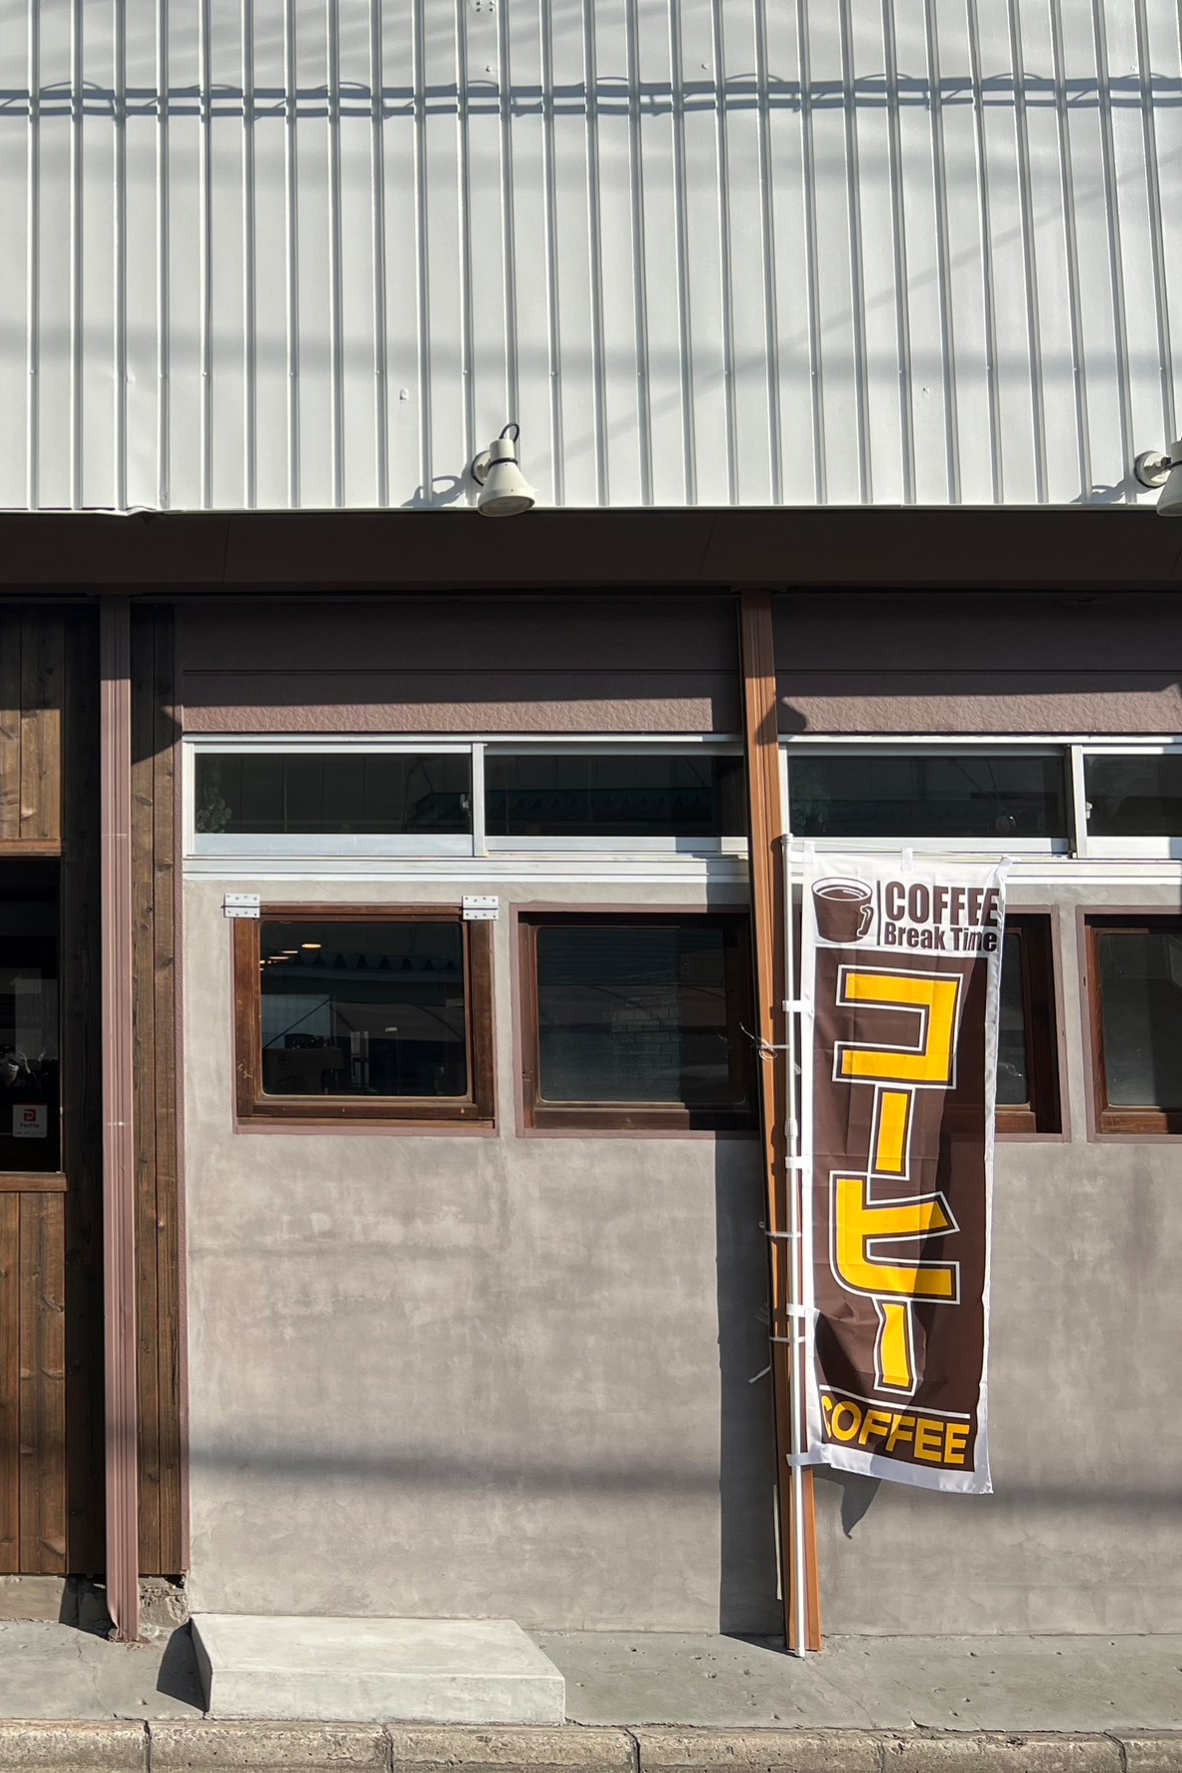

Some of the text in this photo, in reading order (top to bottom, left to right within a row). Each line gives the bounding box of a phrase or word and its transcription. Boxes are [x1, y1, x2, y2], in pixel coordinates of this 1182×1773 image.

[884, 881, 1000, 927] COFFEE
[884, 921, 946, 950] Break
[829, 964, 963, 1396] コーヒー
